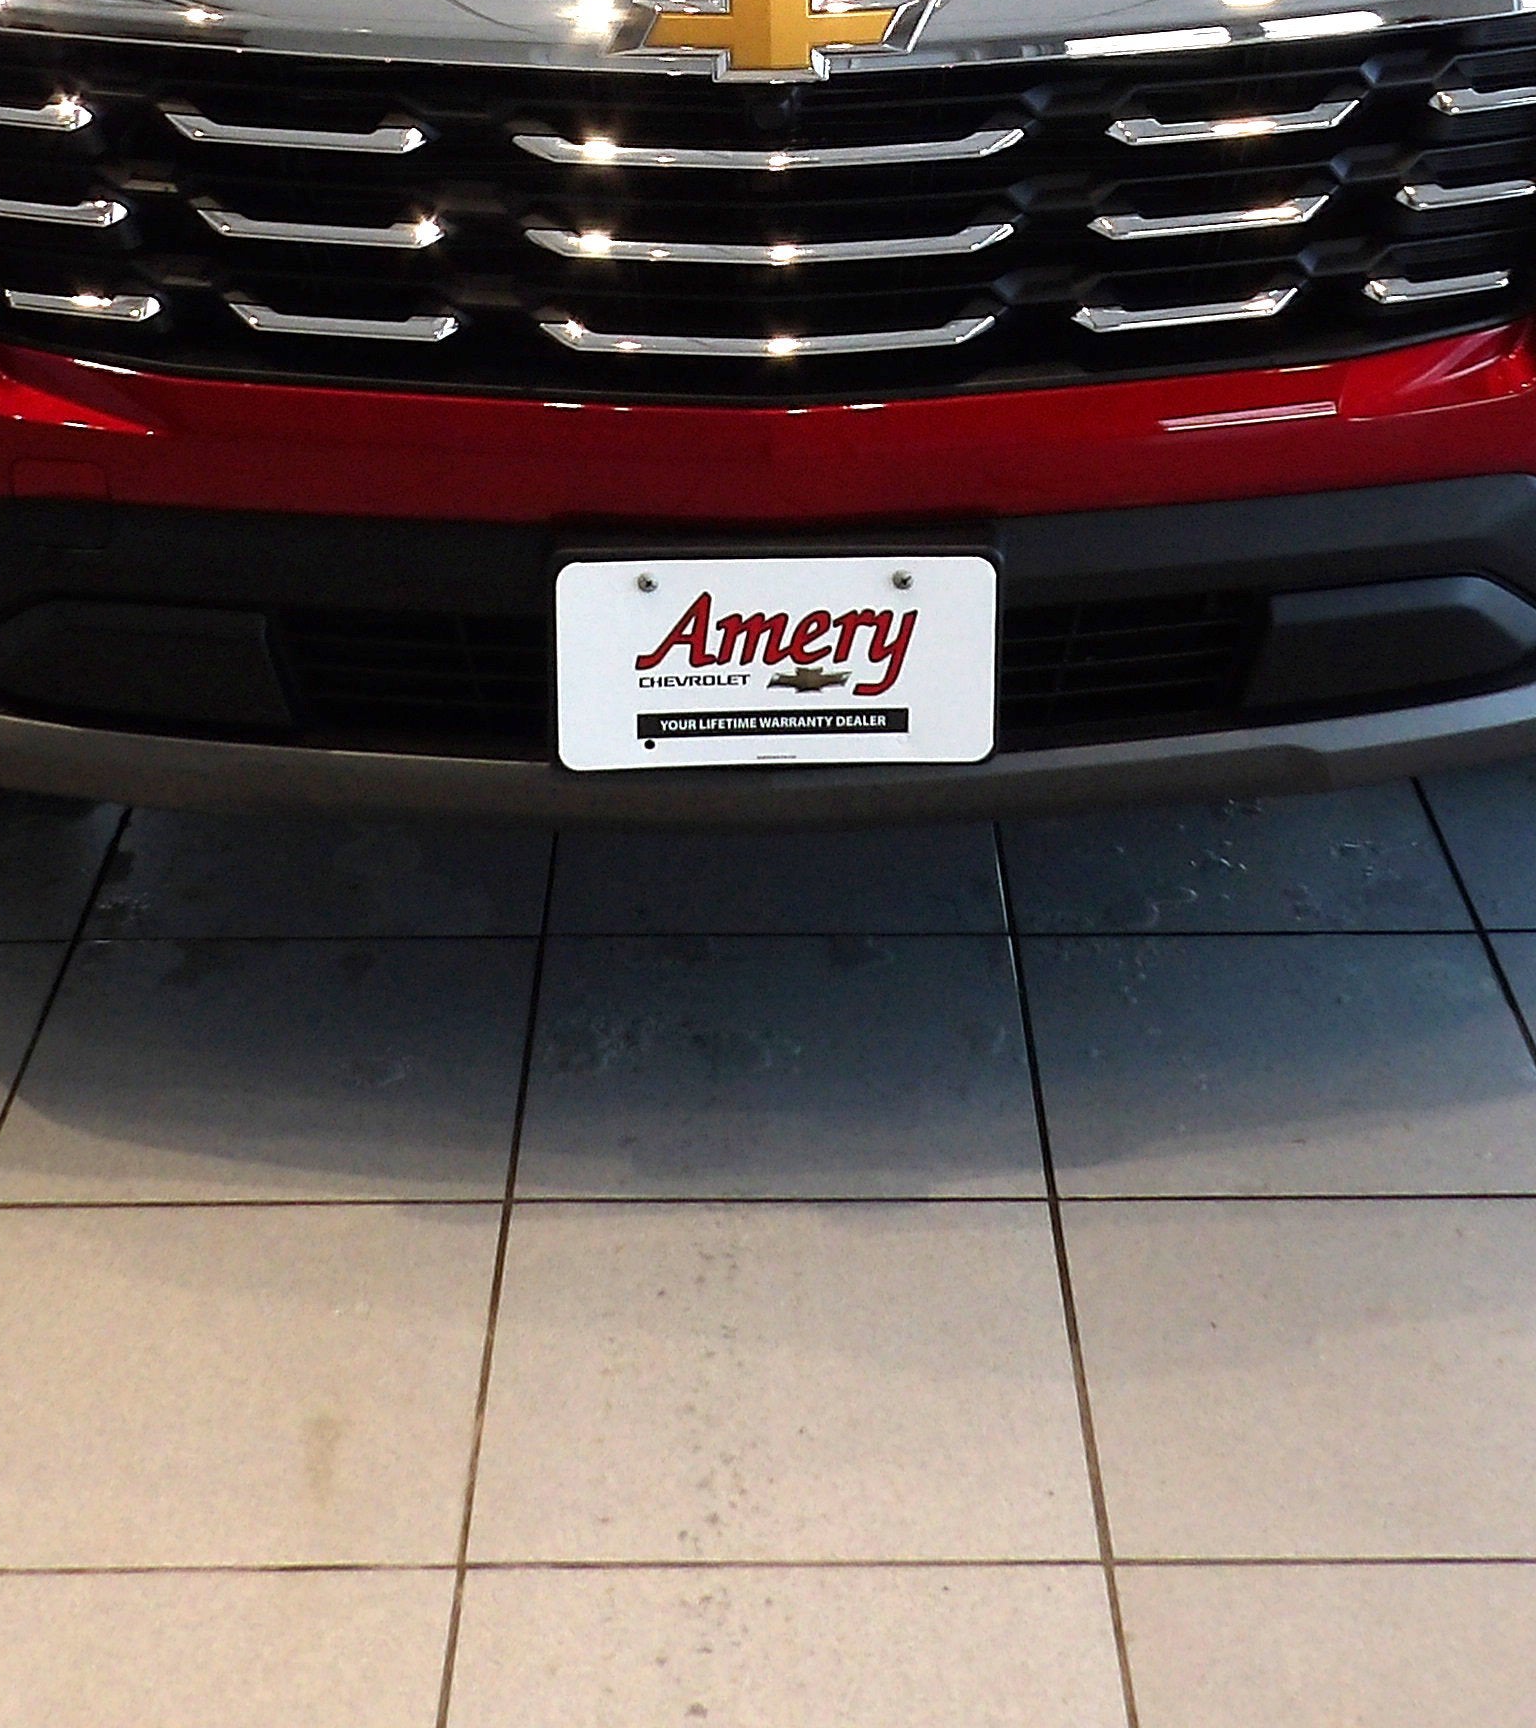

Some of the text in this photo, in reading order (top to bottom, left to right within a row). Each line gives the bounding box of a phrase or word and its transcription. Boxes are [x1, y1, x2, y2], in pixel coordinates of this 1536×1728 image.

[635, 592, 918, 696] Amery
[638, 674, 751, 689] CHEVROLET
[660, 714, 886, 731] YOUR LIFETIME WARRANTY DEALER
